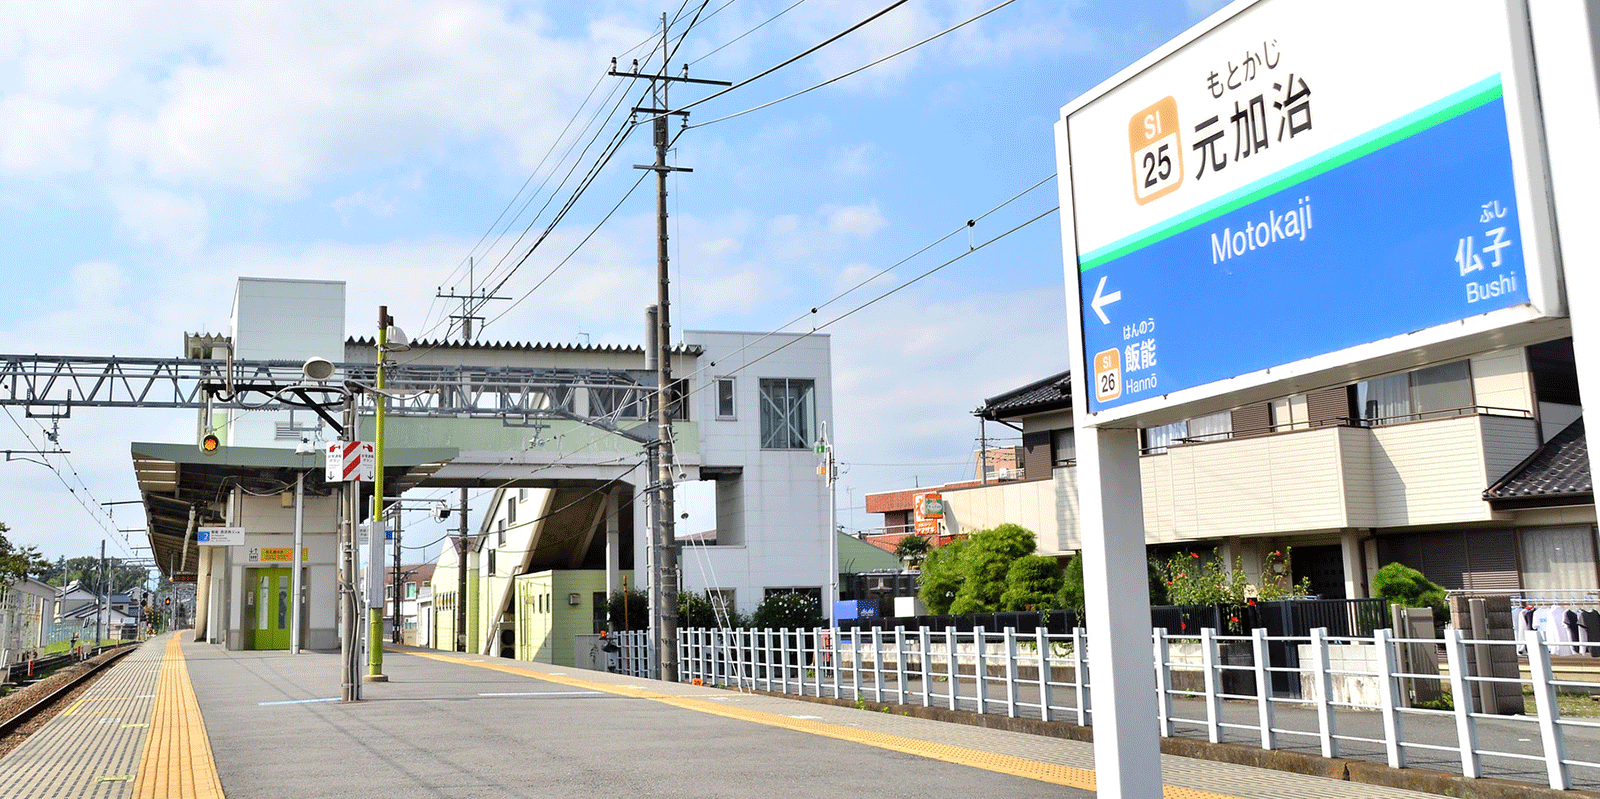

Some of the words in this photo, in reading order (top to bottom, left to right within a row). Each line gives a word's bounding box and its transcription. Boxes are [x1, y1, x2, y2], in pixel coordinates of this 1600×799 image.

[1207, 39, 1280, 99] もとかじ
[1144, 110, 1162, 139] SI
[1192, 73, 1312, 181] 元加治
[1143, 143, 1172, 189] 25
[1480, 200, 1508, 223] ぶし
[1211, 196, 1312, 264] Motokaji
[1455, 227, 1511, 276] 仏子
[1466, 271, 1516, 303] Bushi
[1123, 318, 1155, 340] はんのう
[1102, 355, 1112, 369] SI
[1125, 338, 1157, 373] 飯能
[1101, 373, 1115, 393] 26
[1125, 373, 1157, 395] Hannō
